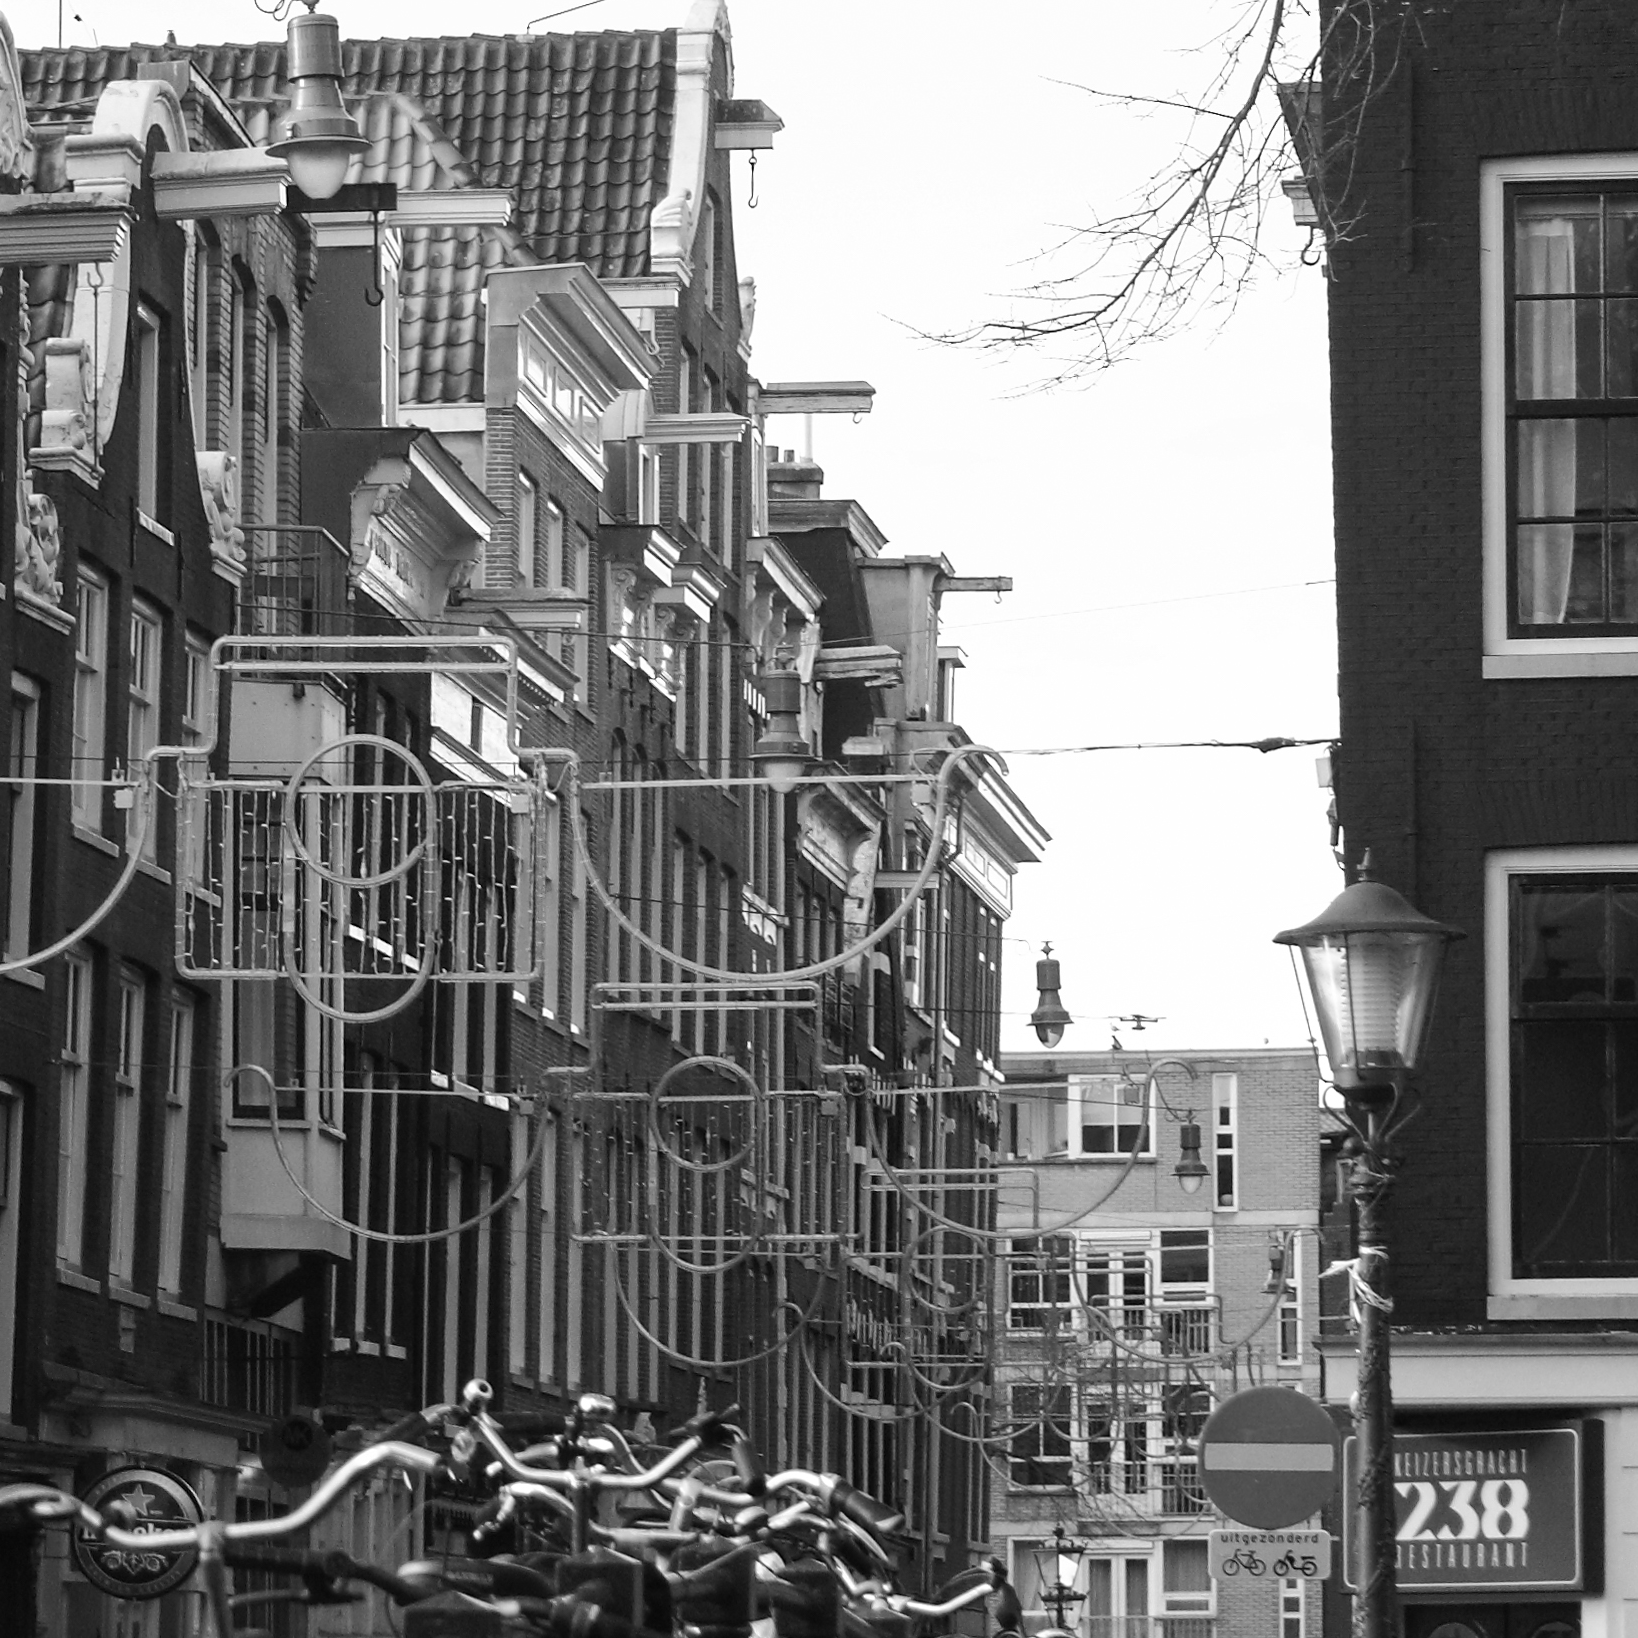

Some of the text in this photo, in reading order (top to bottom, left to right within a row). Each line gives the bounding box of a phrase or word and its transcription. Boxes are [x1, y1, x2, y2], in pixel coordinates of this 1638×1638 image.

[1394, 1448, 1529, 1477] KEIZERSGRACHT
[1394, 1479, 1530, 1541] 238
[1220, 1532, 1319, 1545] uitgezonderd
